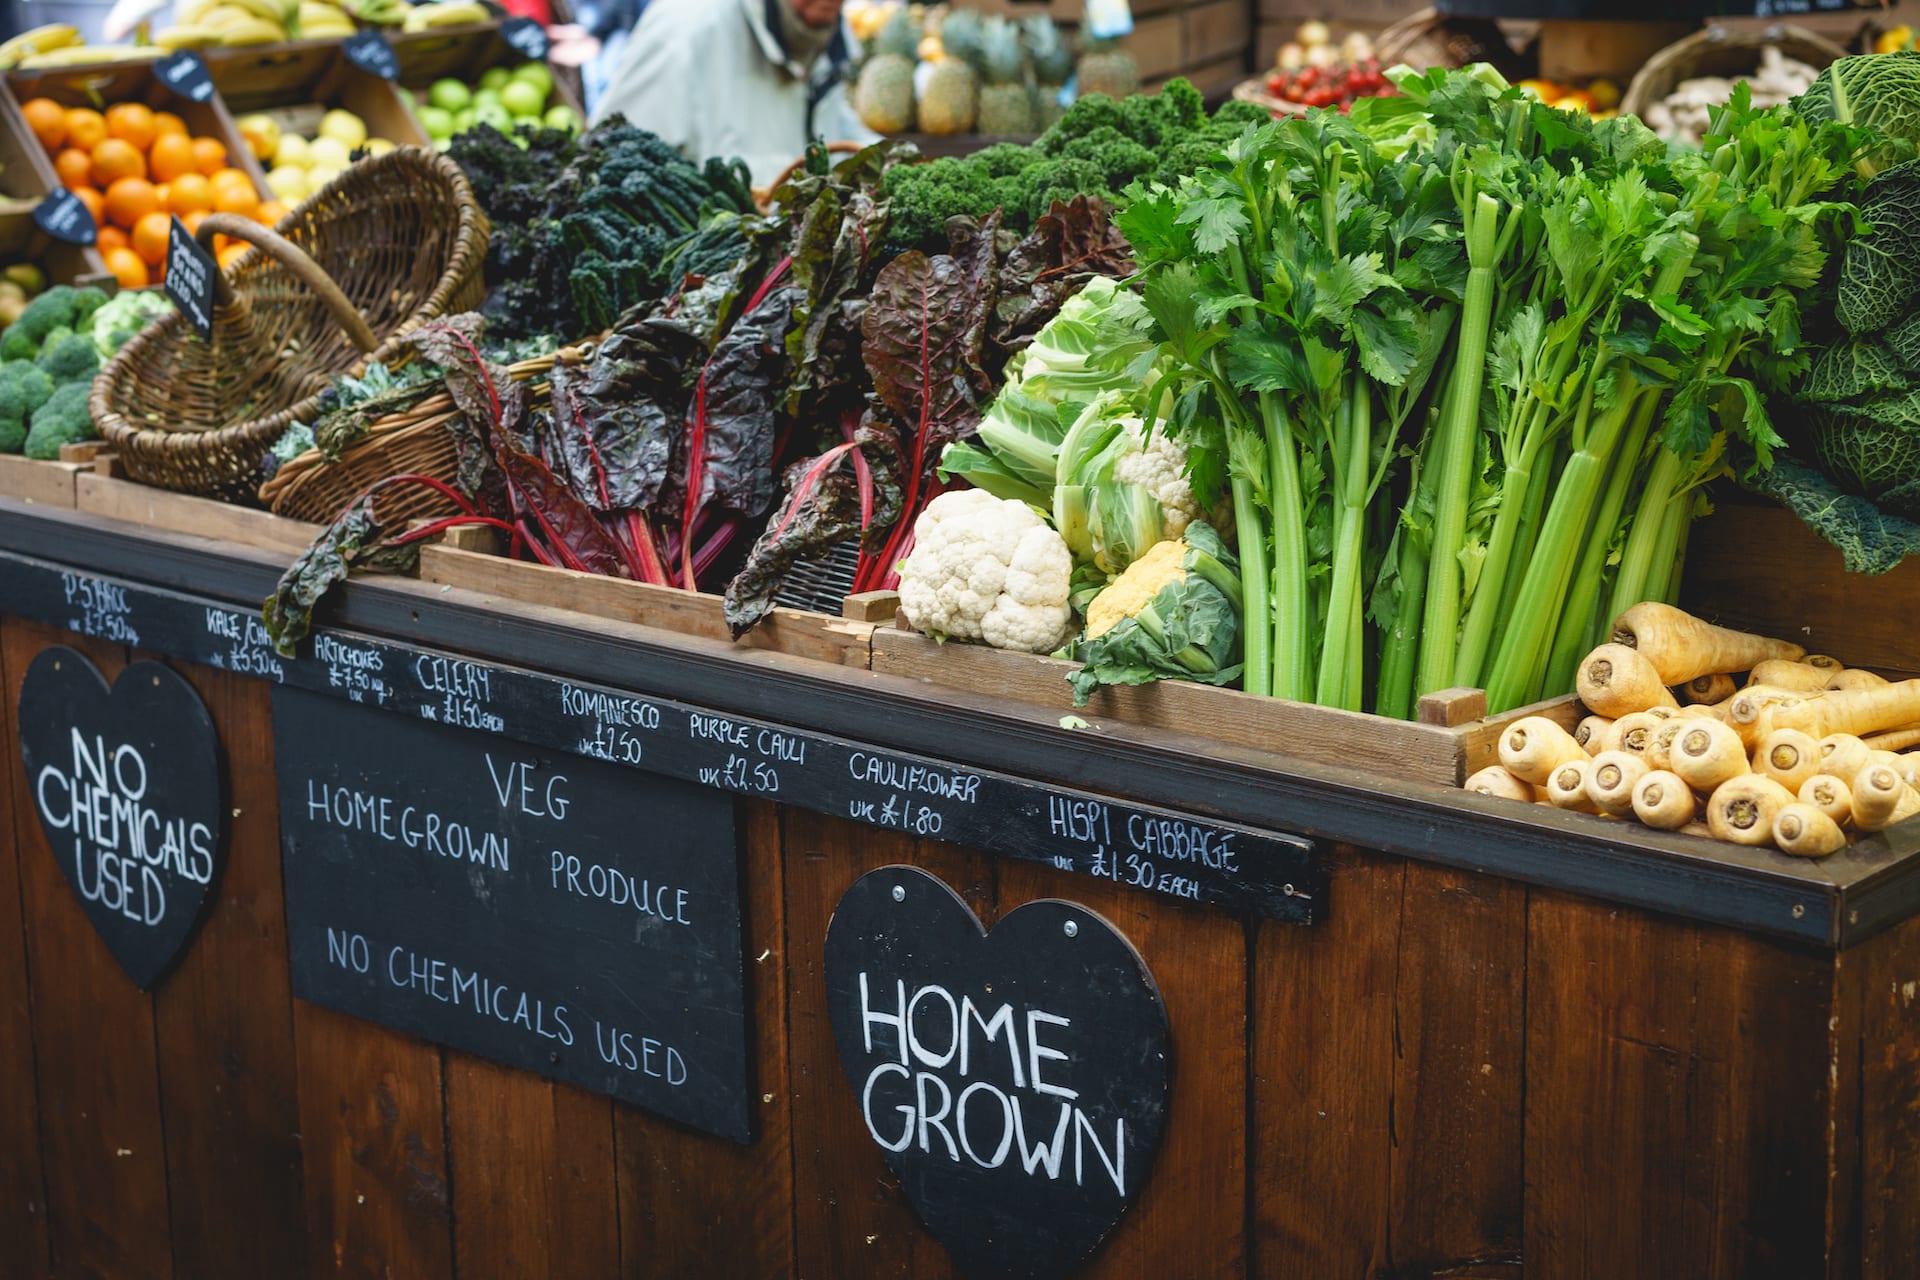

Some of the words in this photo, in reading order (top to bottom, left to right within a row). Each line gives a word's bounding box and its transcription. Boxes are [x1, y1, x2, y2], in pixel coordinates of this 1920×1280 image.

[315, 635, 383, 670] ARTICHOKES
[416, 656, 493, 702] CELERY
[420, 704, 437, 721] UK
[561, 683, 659, 729] ROMANESCO
[70, 726, 147, 801] NO
[690, 713, 750, 748] PURPLE
[758, 730, 805, 764] CAULI
[485, 753, 571, 820] VEG
[699, 767, 721, 788] UK
[723, 754, 778, 792] £2.50
[849, 752, 981, 803] CAULIFLOWER
[38, 764, 214, 884] CHEMICALS
[850, 800, 875, 823] UK
[882, 794, 942, 834] £1.80
[1050, 796, 1110, 845] HISPI
[1128, 815, 1239, 872] CABBAGE
[75, 838, 166, 926] USED
[552, 850, 692, 926] PRODUCE
[1054, 855, 1074, 871] UK
[327, 926, 369, 974] NO
[389, 945, 575, 1047] CHEMICALS
[596, 1021, 687, 1086] USED
[859, 972, 1079, 1100] HOME
[863, 1062, 1125, 1197] GROWN
